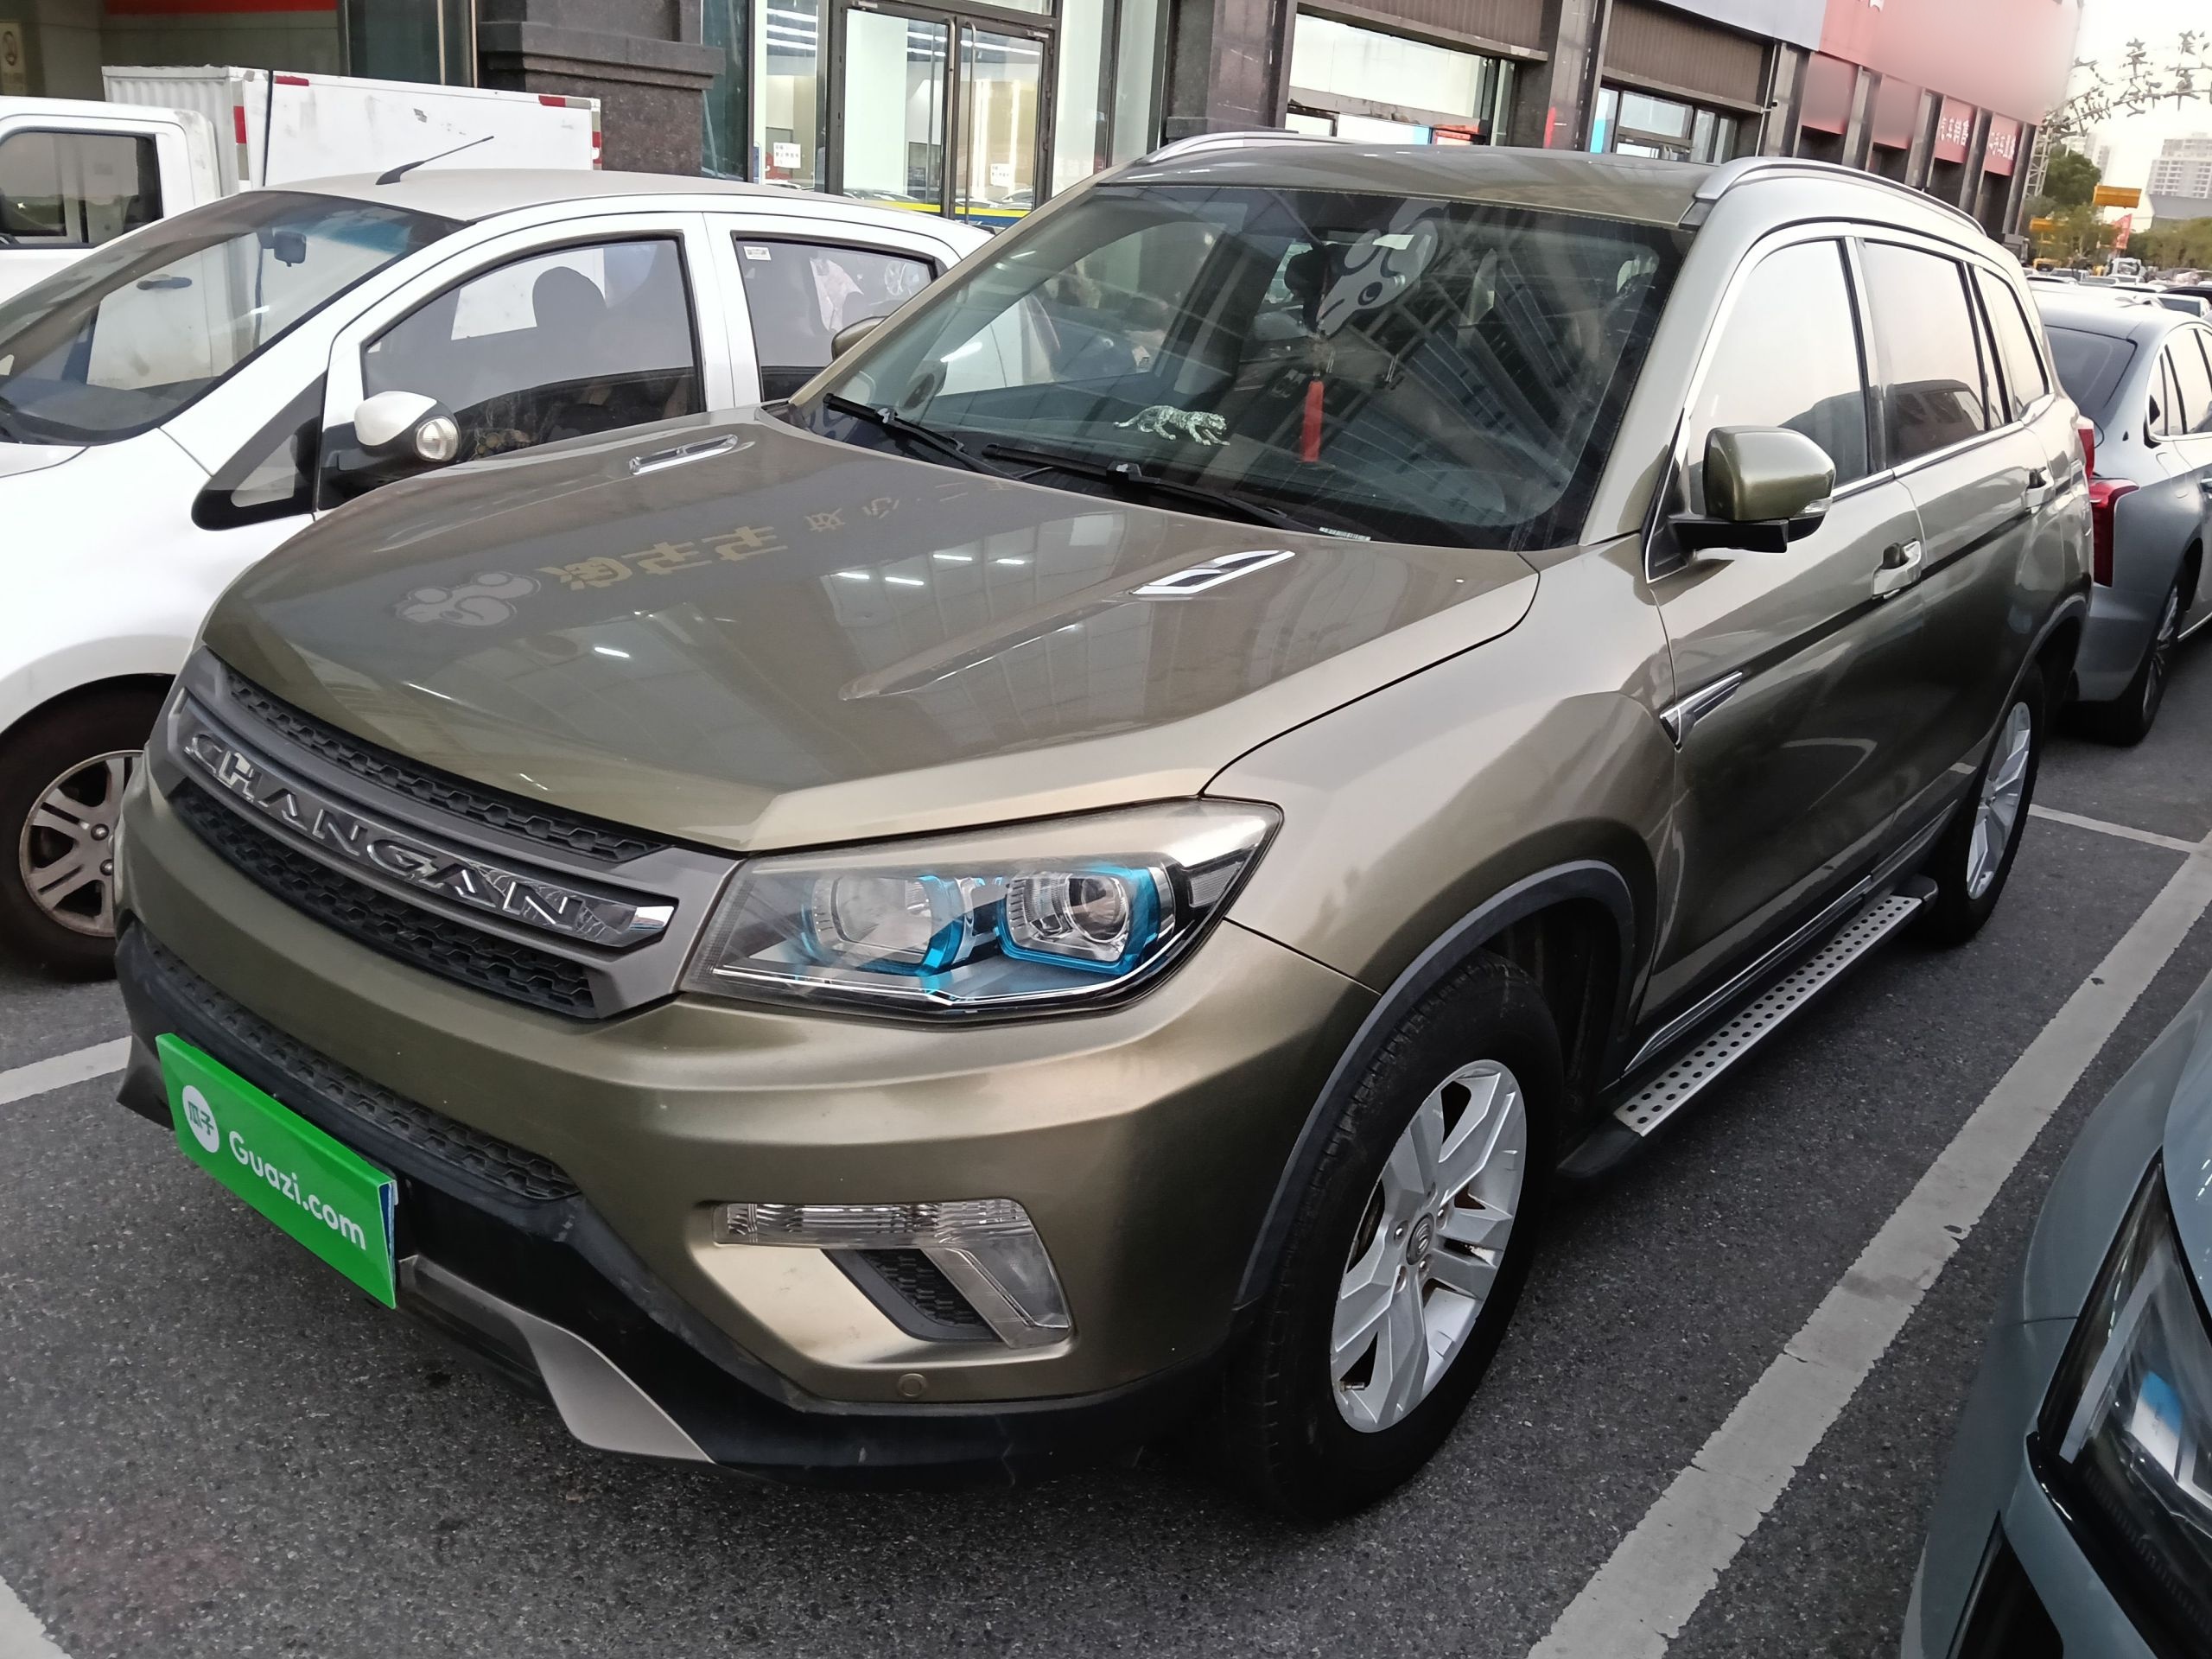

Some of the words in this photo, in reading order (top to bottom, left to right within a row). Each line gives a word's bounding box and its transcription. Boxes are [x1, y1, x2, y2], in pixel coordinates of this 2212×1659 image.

[184, 734, 585, 931] CHANGAN
[188, 1101, 215, 1136] 瓜子
[229, 1131, 366, 1251] Guazi.com
